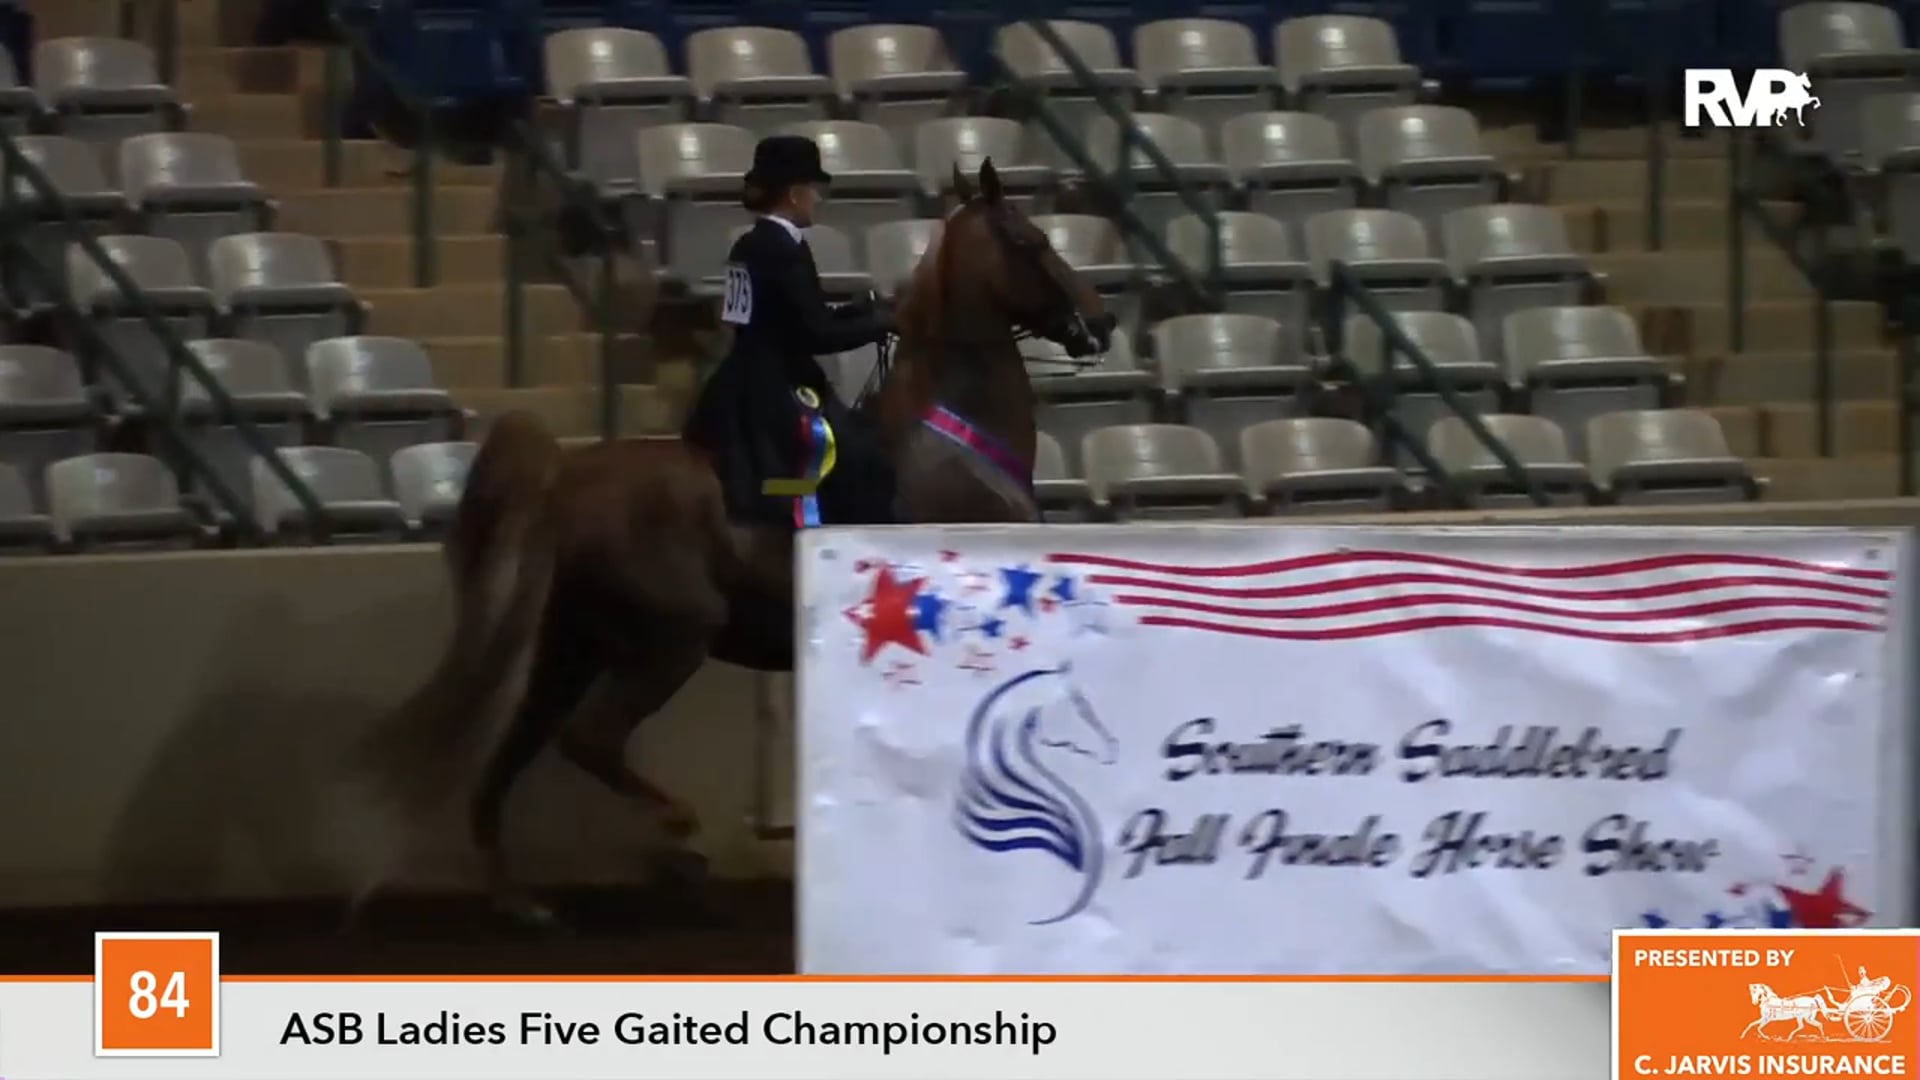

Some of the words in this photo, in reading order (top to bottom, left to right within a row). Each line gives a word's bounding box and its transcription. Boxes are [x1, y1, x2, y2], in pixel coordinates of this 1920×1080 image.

[1161, 717, 1381, 781] Southern
[1397, 719, 1684, 783] Saddlebred
[1117, 808, 1232, 880] Fall
[1238, 808, 1403, 881] Finale
[1410, 811, 1566, 878] Horse
[1582, 814, 1722, 877] Show
